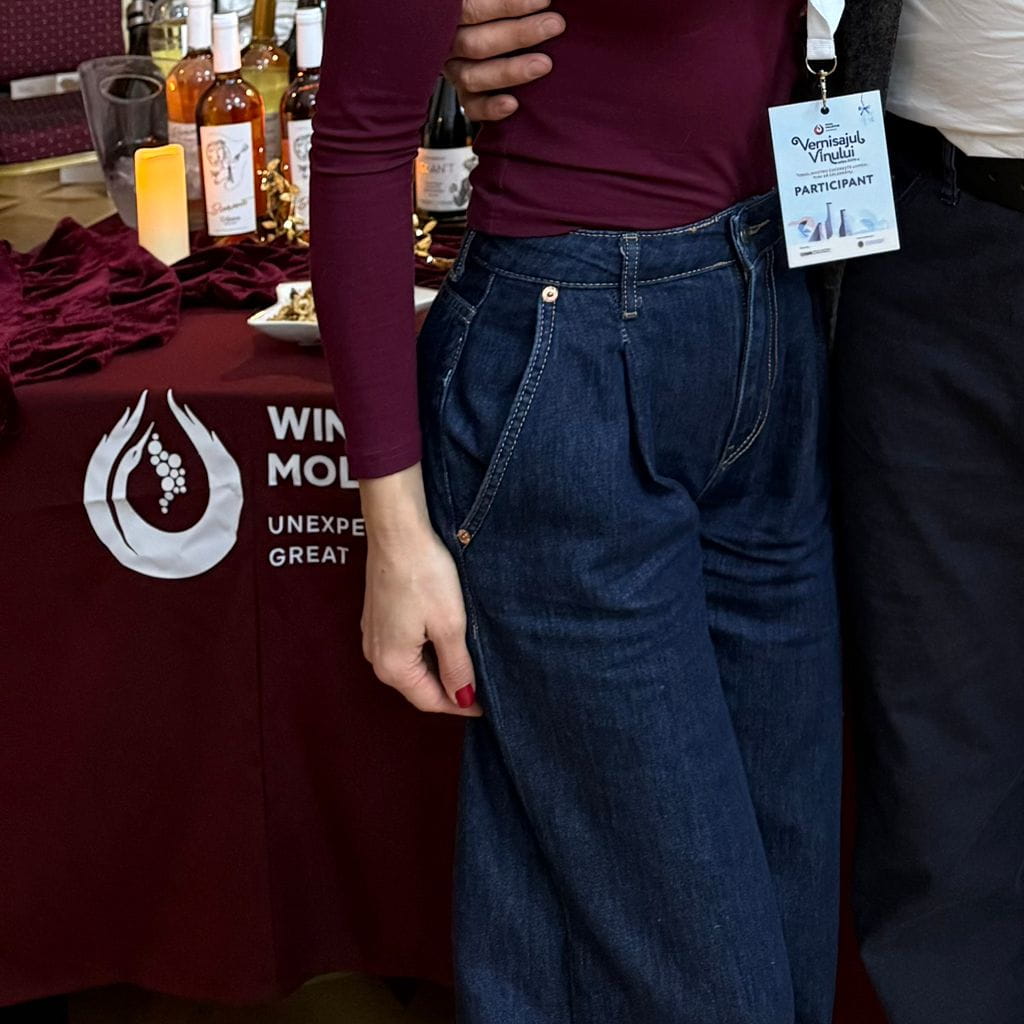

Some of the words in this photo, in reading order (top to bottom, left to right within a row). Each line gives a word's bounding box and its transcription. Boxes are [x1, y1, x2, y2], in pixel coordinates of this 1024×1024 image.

[791, 130, 866, 151] Vernisajul
[808, 146, 855, 164] Vinului
[794, 174, 874, 197] PARTICIPANT
[267, 452, 360, 489] MOL
[267, 514, 365, 537] UNEXPE
[268, 545, 350, 567] GREAT
